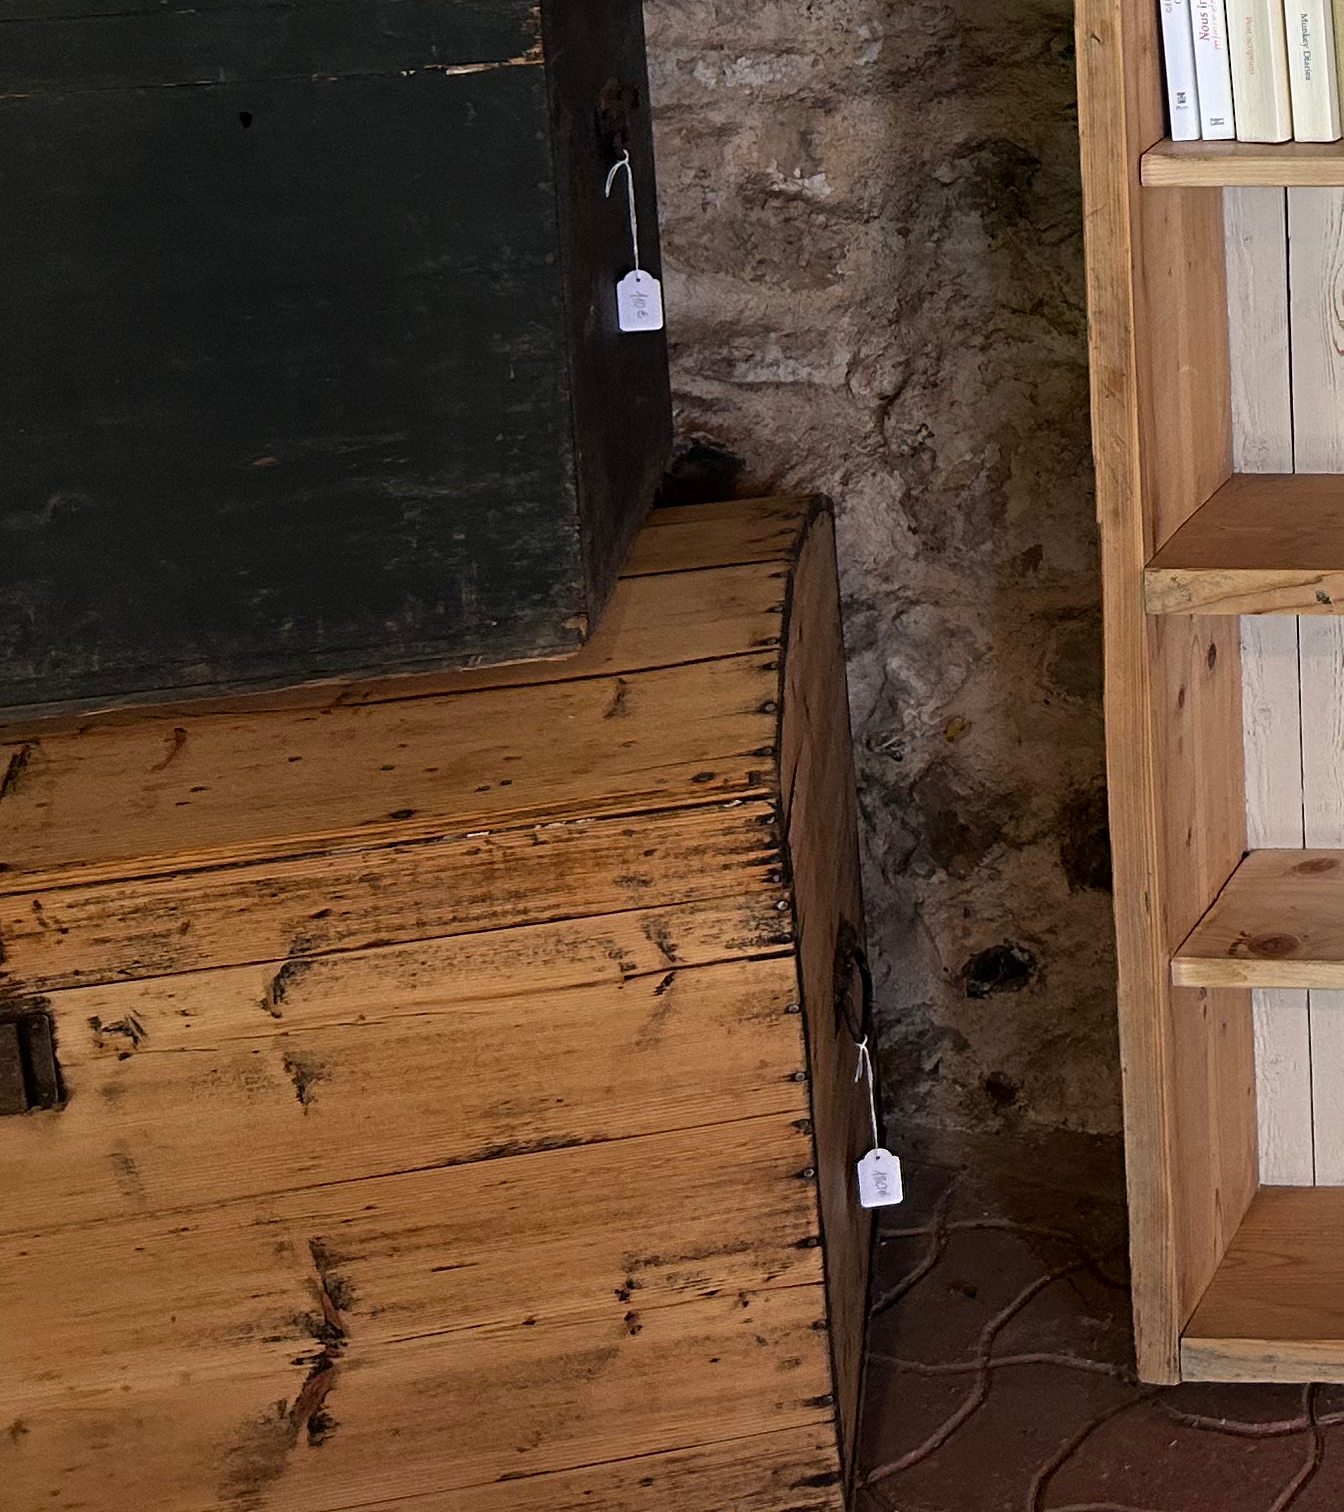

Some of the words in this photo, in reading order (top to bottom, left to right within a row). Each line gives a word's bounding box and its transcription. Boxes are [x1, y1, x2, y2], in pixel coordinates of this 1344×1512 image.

[1197, 11, 1210, 41] Nous
[1298, 12, 1310, 47] Munkey
[1302, 50, 1313, 81] Diaries
